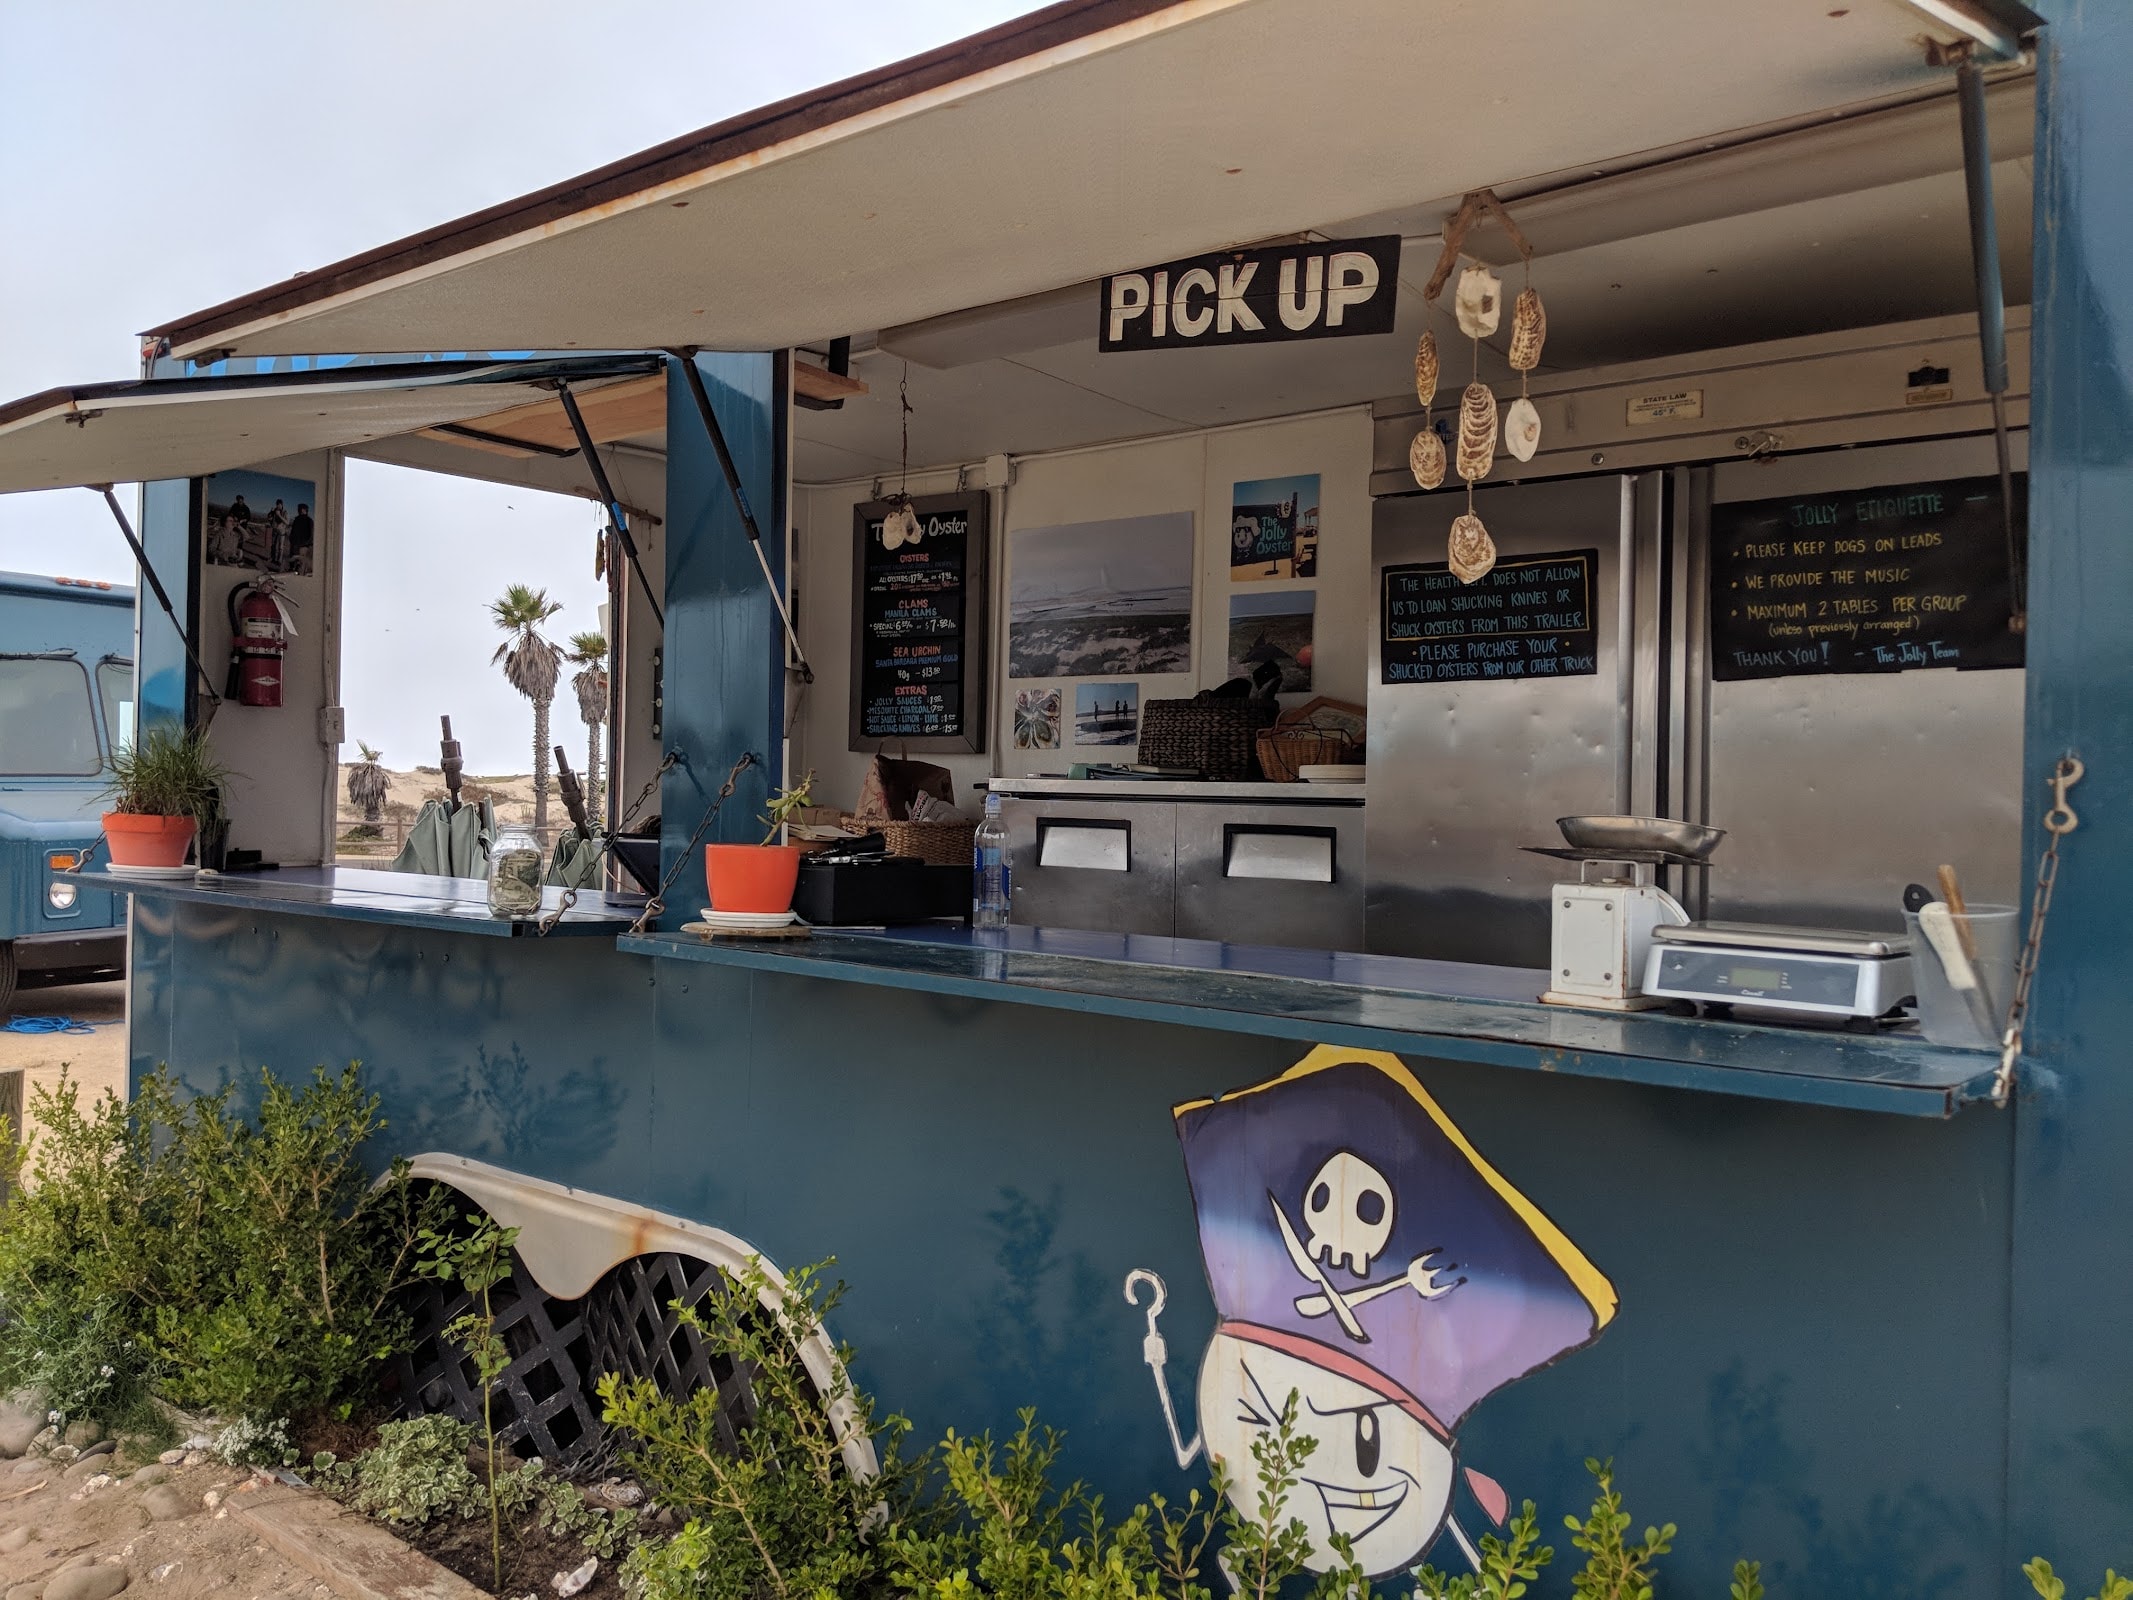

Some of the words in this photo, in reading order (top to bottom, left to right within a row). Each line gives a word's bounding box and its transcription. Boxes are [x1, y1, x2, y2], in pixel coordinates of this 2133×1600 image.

[1109, 262, 1265, 342] PICK
[1278, 252, 1379, 330] UP
[1792, 503, 1839, 527] JOLLY
[1857, 494, 1944, 521] ETIQUETTE
[929, 516, 967, 536] Oyster
[1262, 517, 1277, 526] The
[1260, 526, 1287, 542] Jolly
[1256, 541, 1292, 554] Oyster
[1746, 542, 1785, 558] PLEASE
[1794, 541, 1825, 556] KEEP
[1835, 539, 1865, 554] DOGS
[1875, 538, 1894, 552] ON
[1901, 533, 1942, 550] LEADS
[900, 554, 929, 563] OYSTERS
[1400, 578, 1419, 592] THE
[1425, 575, 1459, 590] HEALTH
[1493, 571, 1517, 585] DOES
[1520, 569, 1540, 584] NOT
[1545, 566, 1580, 581] ALLOW
[1746, 576, 1764, 590] WE
[1770, 572, 1822, 588] PROVIDE
[1830, 570, 1855, 584] THE
[1865, 568, 1911, 583] MUSIC
[898, 599, 928, 608] CLAMS
[1392, 602, 1404, 615] US
[1406, 600, 1418, 614] TO
[1421, 598, 1446, 613] LOAN
[1451, 595, 1503, 611] SHUCKING
[1511, 591, 1547, 607] KNIVES
[1557, 589, 1571, 603] OR
[1747, 602, 1807, 620] MAXIMUM
[1817, 601, 1827, 616] 2
[1832, 599, 1878, 614] TABLES
[1893, 597, 1916, 613] PER
[1921, 595, 1967, 611] GROUP
[885, 609, 909, 618] MANILA
[912, 608, 937, 616] CLAMS
[1392, 622, 1421, 638] SHUCK
[1424, 620, 1464, 636] OYSTERS
[1472, 618, 1498, 632] FROM
[1504, 615, 1528, 630] THIS
[1534, 612, 1584, 628] TRAILER.
[1769, 623, 1802, 638] (unless
[1808, 619, 1858, 640] previously
[1862, 615, 1920, 637] arranged)
[893, 647, 908, 657] SEA
[912, 645, 941, 656] URCHIN
[1419, 644, 1460, 661] PLEASE
[1468, 641, 1519, 658] PURCHASE
[1526, 637, 1558, 653] YOUR
[1734, 651, 1786, 667] THANK
[1788, 642, 1829, 665] YOU!
[1872, 647, 1895, 663] The
[1896, 642, 1927, 664] Jolly
[1930, 640, 1959, 659] Team
[876, 658, 893, 668] SANTA
[918, 655, 942, 665] PREMIUM
[1389, 663, 1432, 679] SHUCKED
[1437, 662, 1478, 678] OYSTERS
[1483, 661, 1504, 676] FROM
[1506, 660, 1525, 675] OUR
[1530, 658, 1558, 674] OTHER
[1561, 655, 1593, 671] TRUCK
[895, 685, 927, 695] EXTRAS
[875, 697, 892, 706] JOLLY
[897, 696, 922, 705] SAUCES
[900, 706, 930, 714] CHARCOAL
[899, 724, 920, 732] KNIVES
